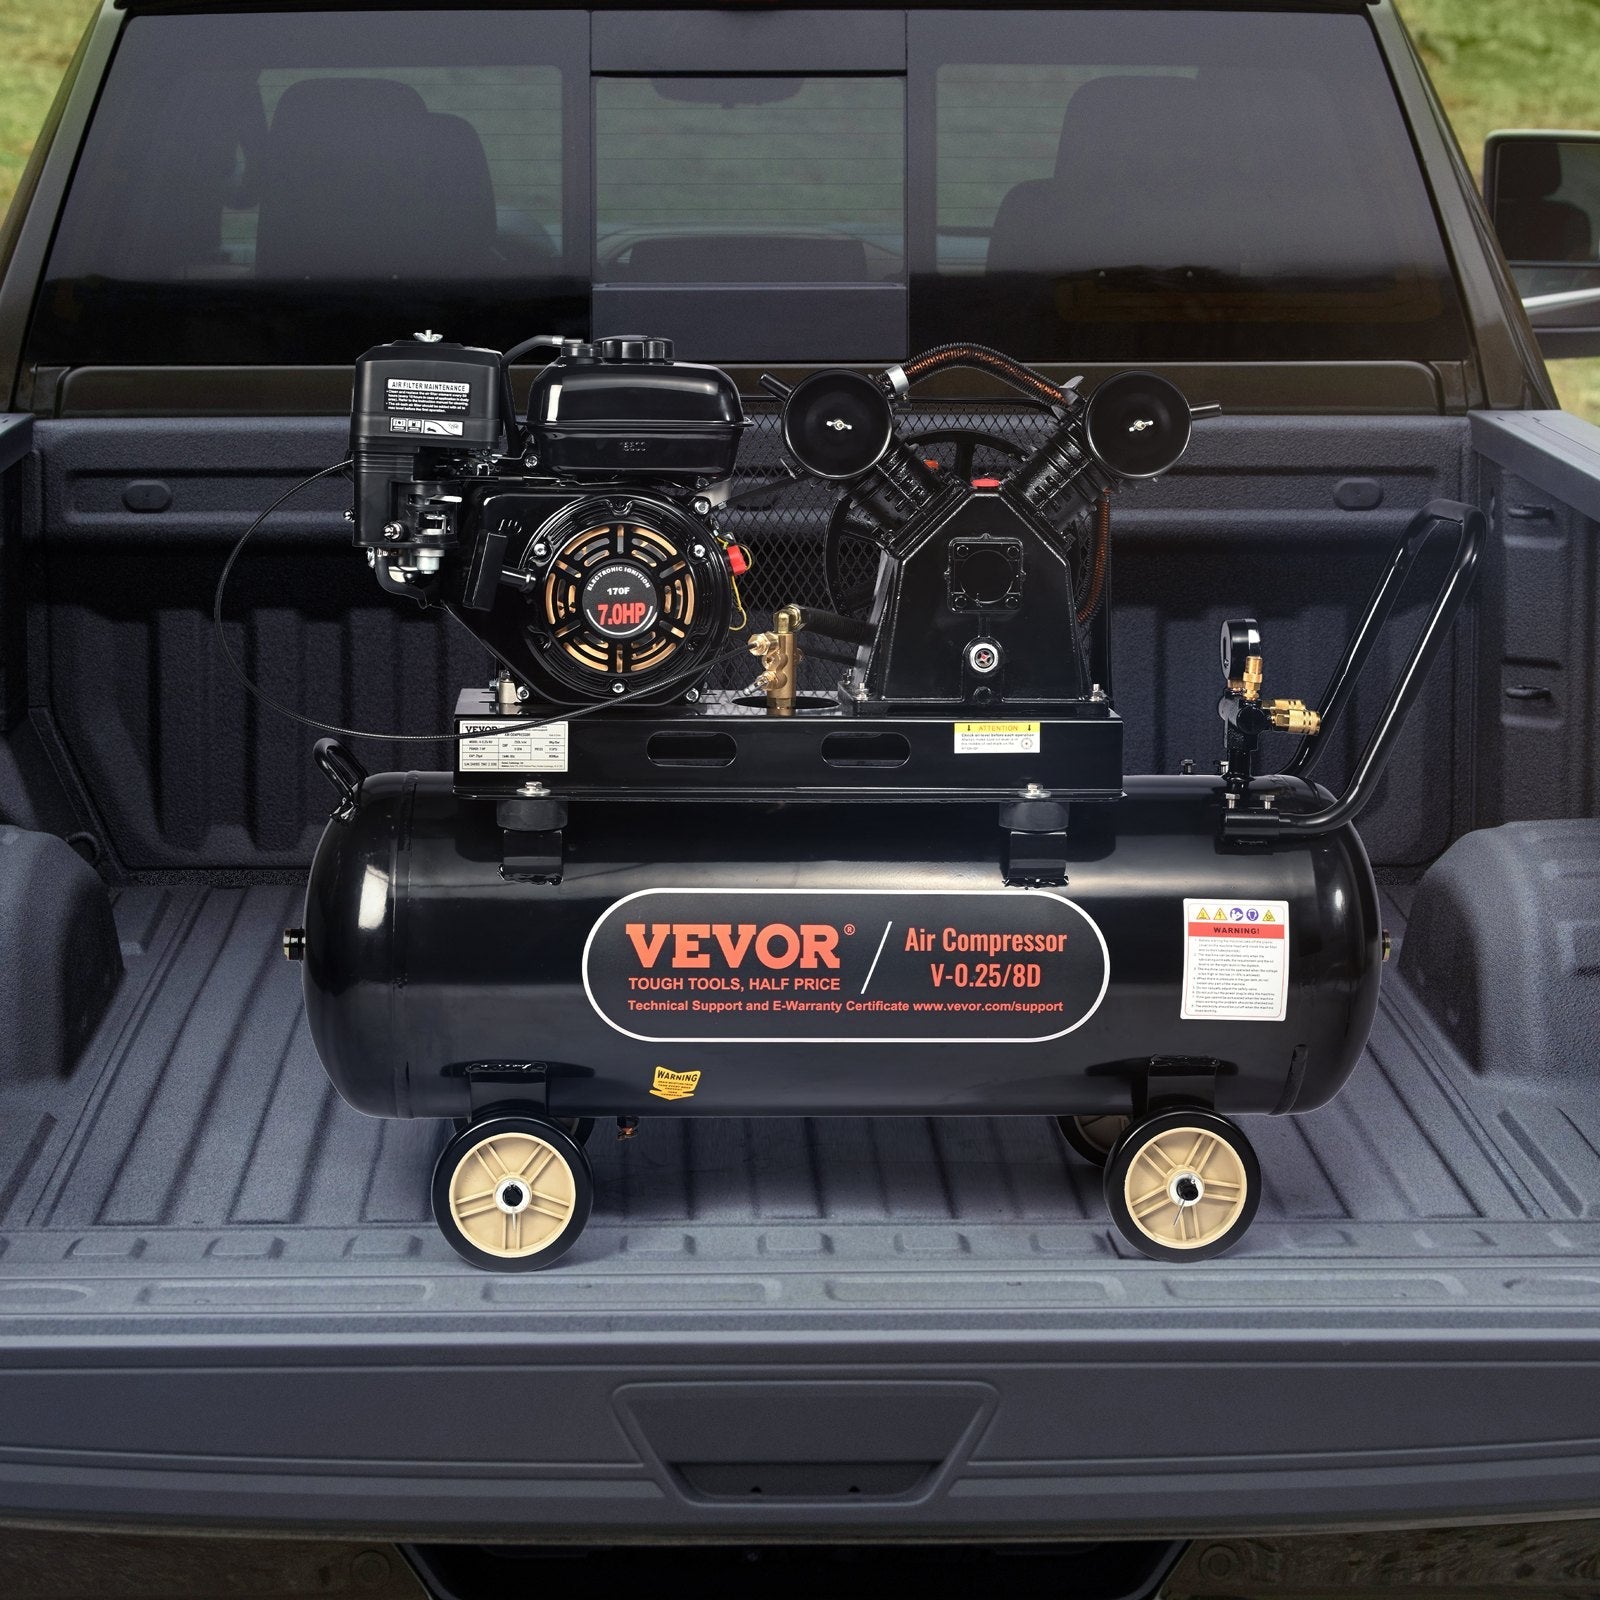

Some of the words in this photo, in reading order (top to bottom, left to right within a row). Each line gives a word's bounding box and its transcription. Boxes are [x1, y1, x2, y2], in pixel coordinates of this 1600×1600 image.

[424, 383, 466, 392] MAINTENANCE
[587, 566, 623, 591] ELECTRONIC
[624, 567, 650, 588] IGNITION
[606, 587, 630, 595] 170F
[598, 602, 646, 626] 7.0HP
[1214, 926, 1260, 934] WARNING!
[904, 928, 936, 952] Air
[943, 928, 1068, 956] Compressor
[931, 964, 1041, 988] V-0.25/8D
[629, 978, 683, 990] TOUGH
[688, 978, 744, 992] TOOLS,
[750, 978, 790, 990] HALF
[794, 978, 840, 990] PRICE
[628, 1000, 688, 1011] Technical
[692, 1000, 742, 1013] Support
[746, 1000, 769, 1011] and
[773, 1000, 842, 1013] E-Warranty
[846, 1000, 909, 1012] Certificate
[913, 1001, 1063, 1014] www.vevor.com/support
[658, 1070, 698, 1082] WARNING
